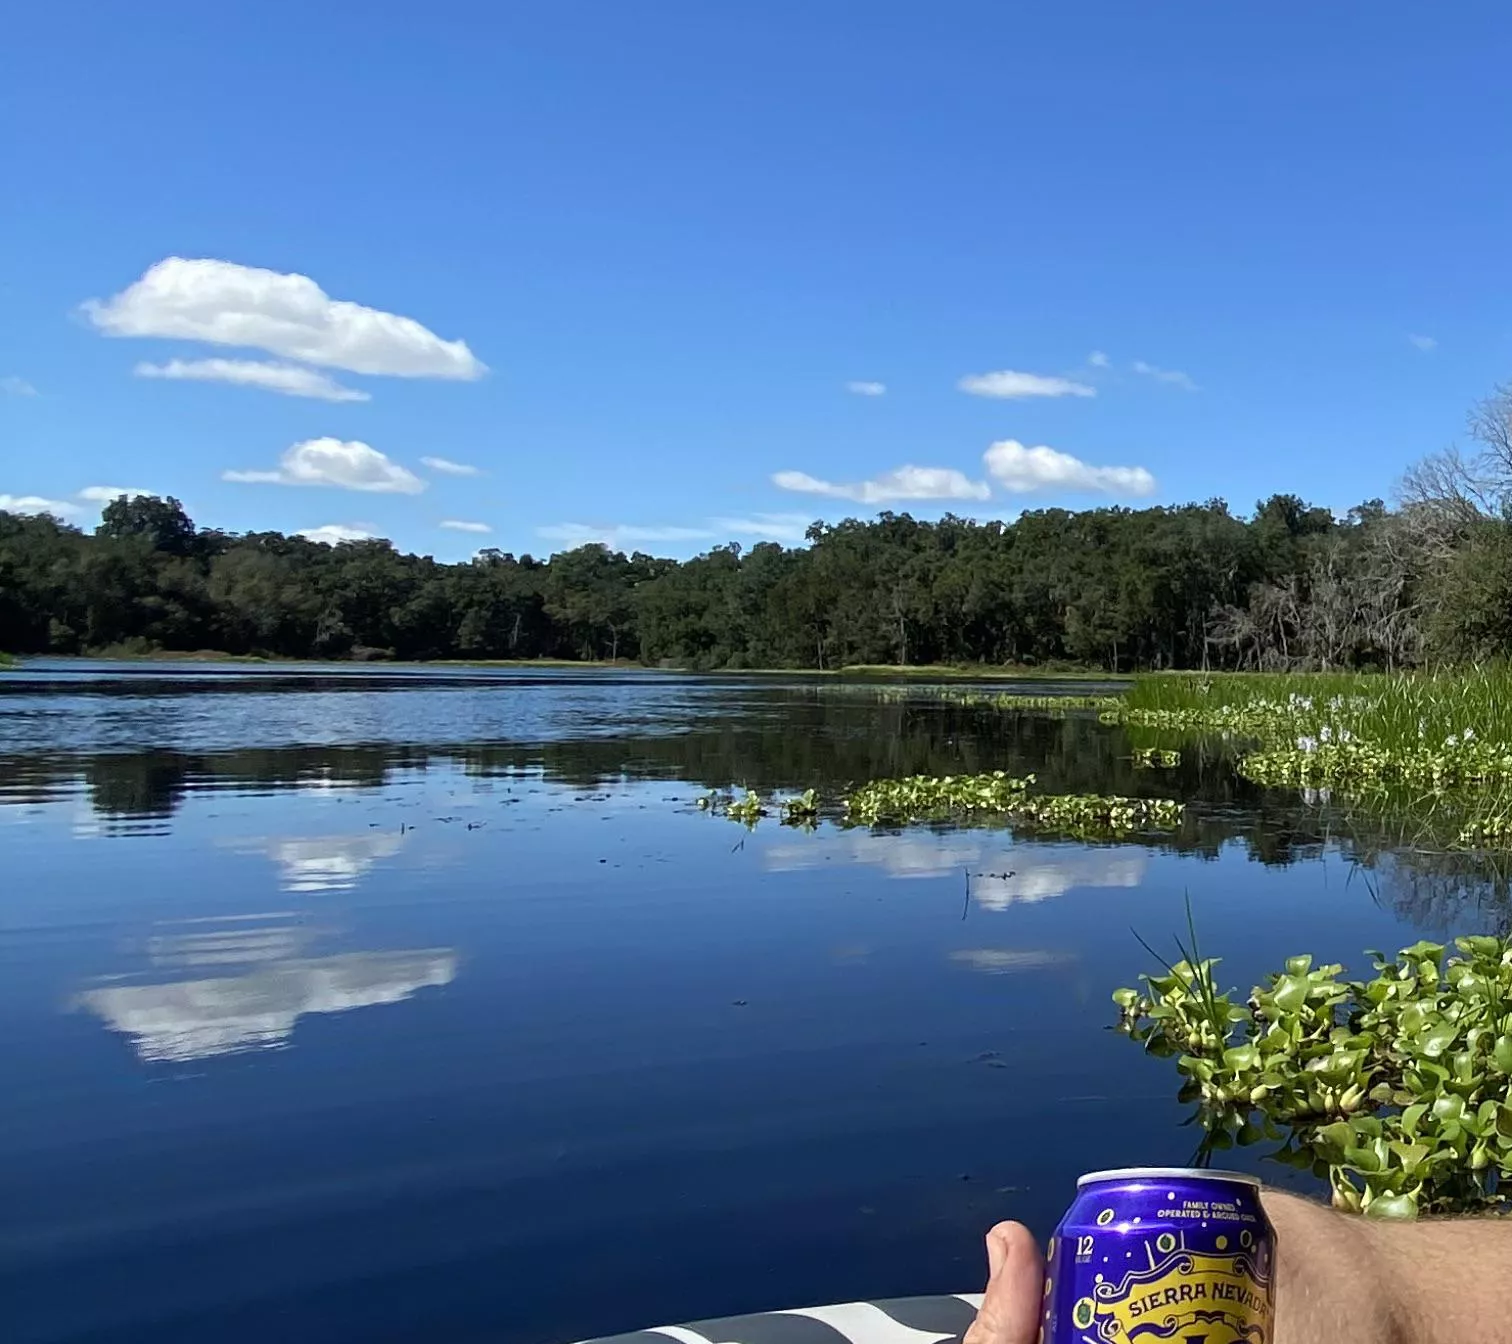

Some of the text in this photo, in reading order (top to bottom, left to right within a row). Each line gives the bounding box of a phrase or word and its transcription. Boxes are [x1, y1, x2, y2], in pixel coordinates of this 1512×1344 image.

[1157, 1209, 1201, 1219] OPERATED
[1203, 1209, 1211, 1219] &
[1076, 1235, 1094, 1256] 12
[1128, 1282, 1207, 1317] SIERRA
